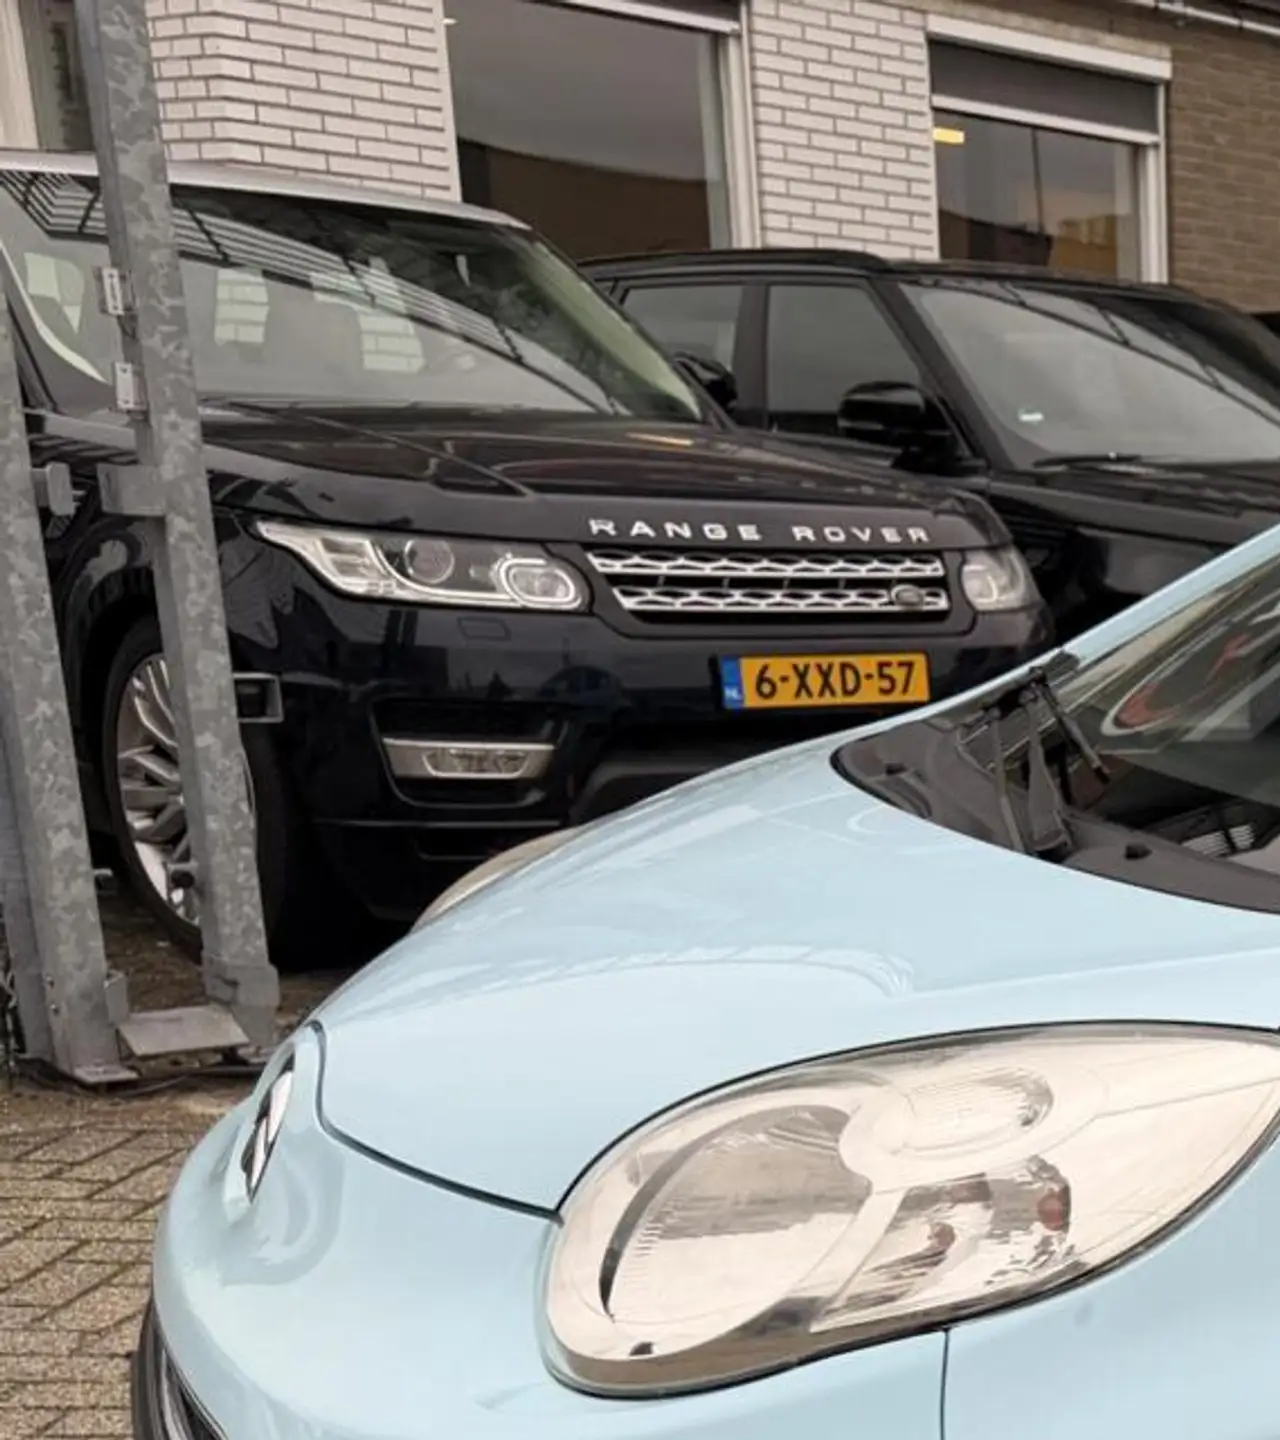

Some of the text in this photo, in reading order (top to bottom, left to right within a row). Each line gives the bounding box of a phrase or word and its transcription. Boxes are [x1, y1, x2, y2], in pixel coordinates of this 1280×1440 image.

[588, 518, 930, 543] RANGE ROVER
[755, 660, 915, 700] 6-XXD-57
